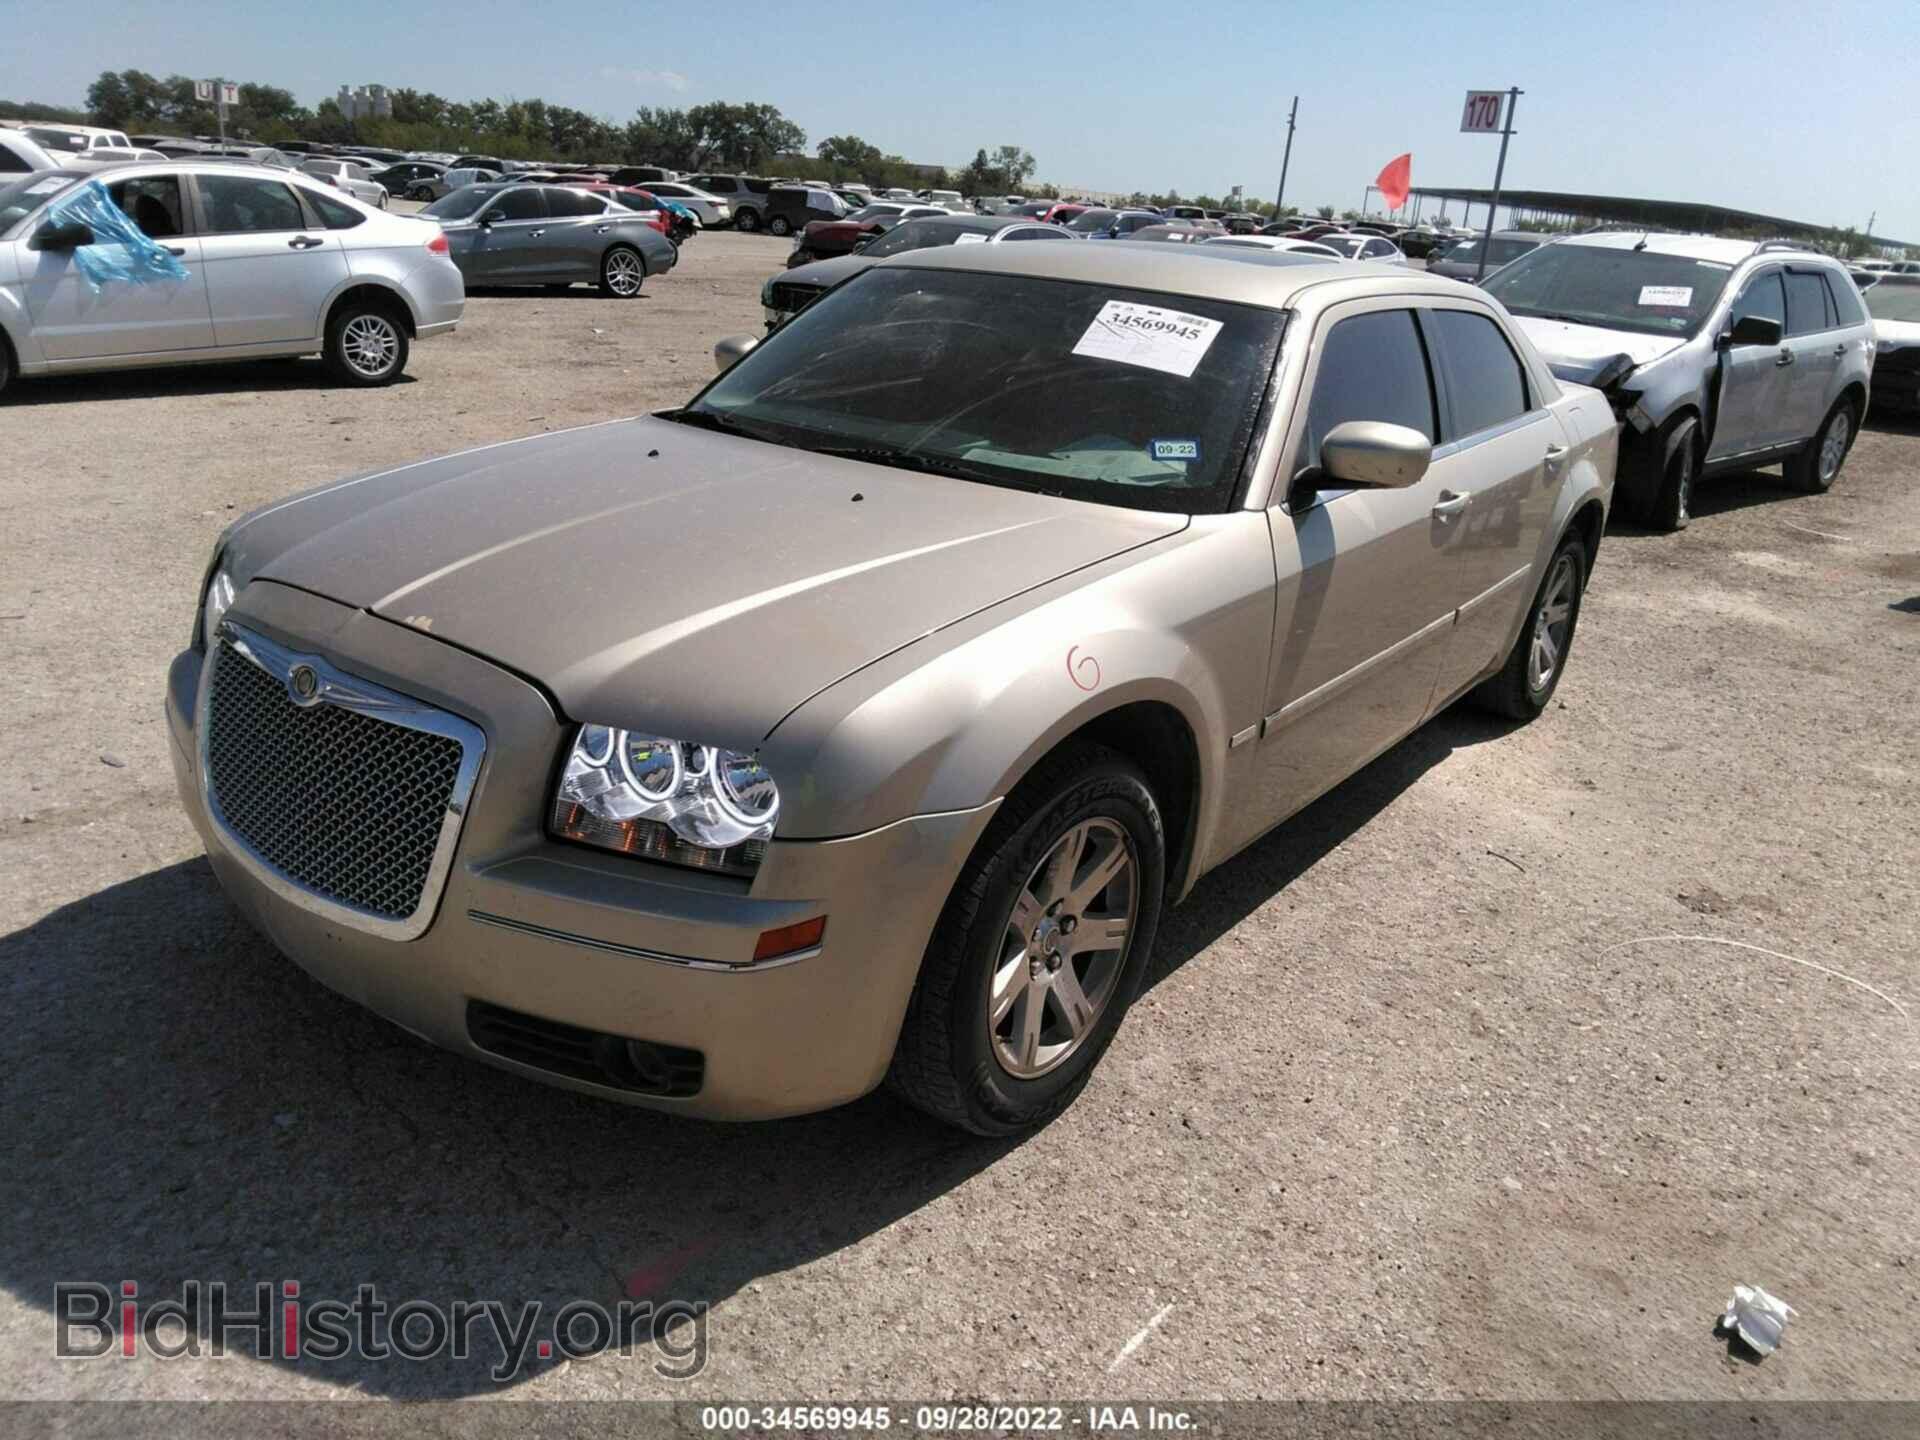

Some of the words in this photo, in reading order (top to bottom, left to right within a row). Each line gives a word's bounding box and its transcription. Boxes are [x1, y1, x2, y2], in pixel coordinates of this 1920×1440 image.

[1468, 95, 1499, 128] 170
[1107, 313, 1201, 341] 34569945
[1066, 644, 1101, 691] 6
